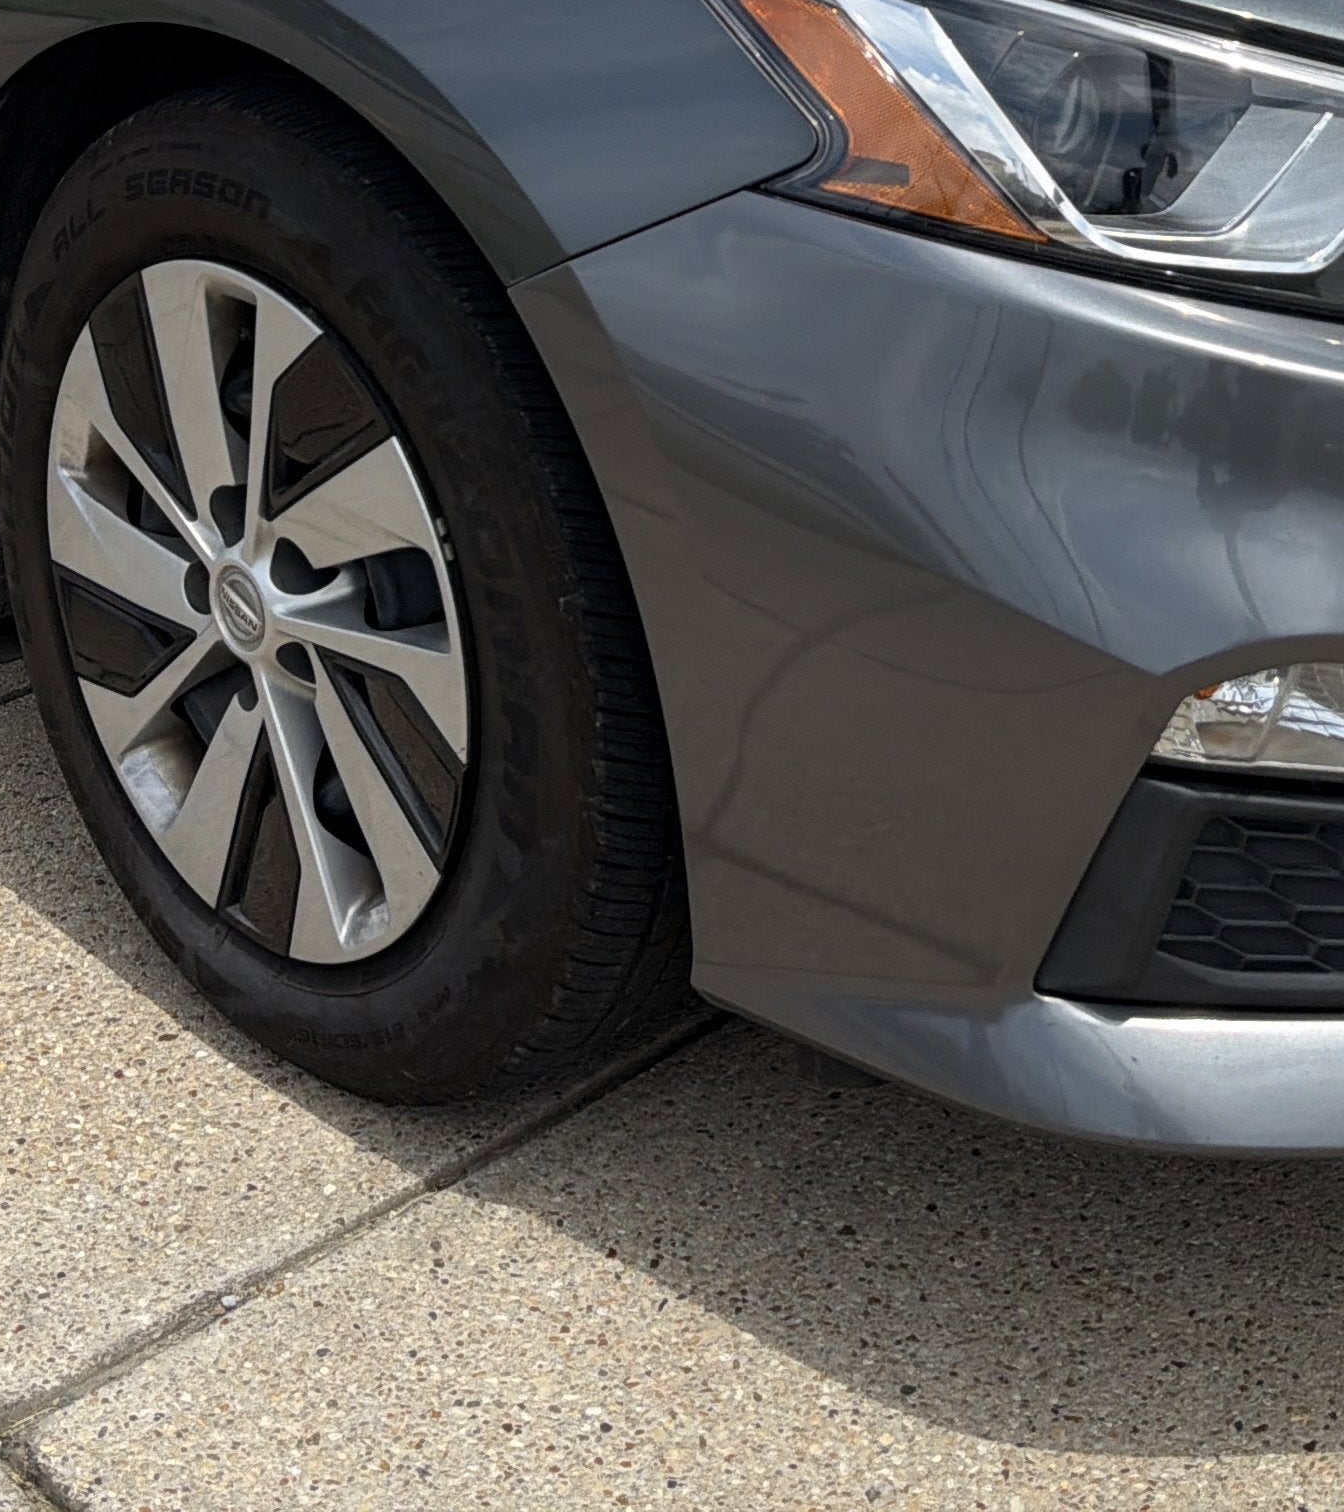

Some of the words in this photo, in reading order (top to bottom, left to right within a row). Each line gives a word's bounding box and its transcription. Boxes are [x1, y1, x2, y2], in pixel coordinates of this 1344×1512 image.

[53, 188, 106, 262] ALL
[124, 167, 272, 221] SEASON
[221, 584, 258, 632] NISSAN
